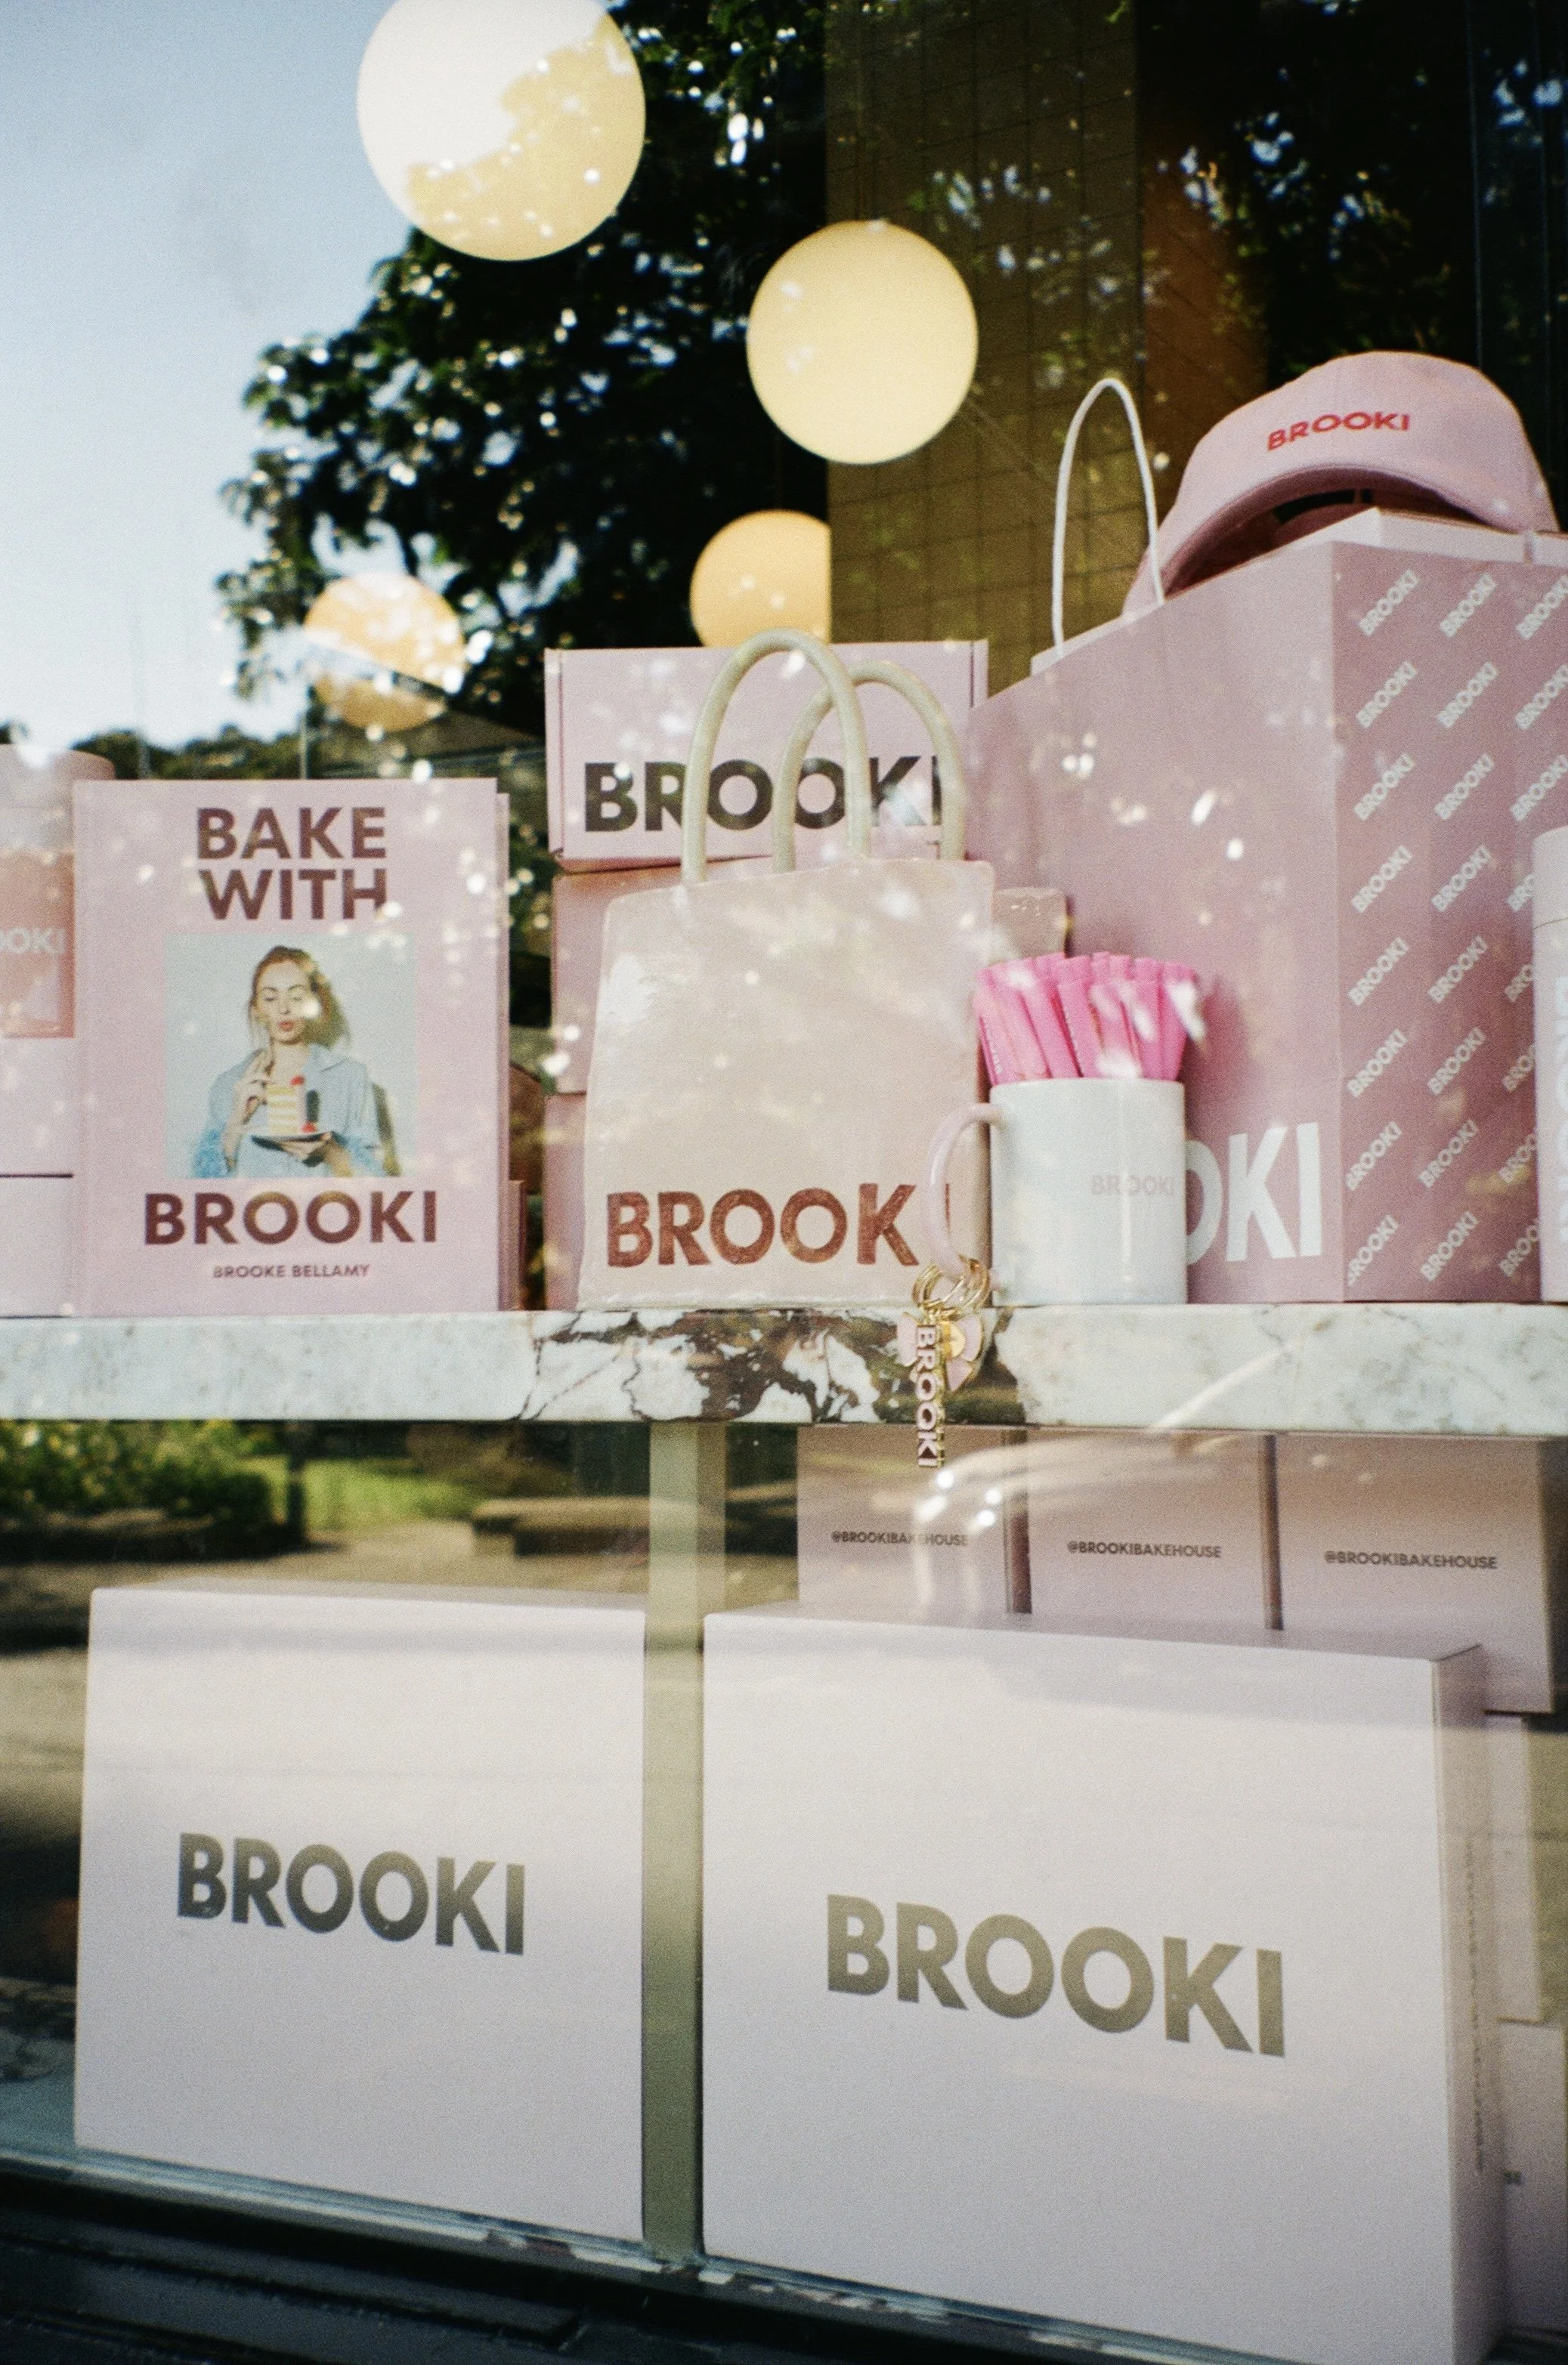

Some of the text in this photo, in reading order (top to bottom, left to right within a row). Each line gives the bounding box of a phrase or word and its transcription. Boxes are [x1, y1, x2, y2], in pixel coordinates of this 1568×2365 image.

[1267, 411, 1410, 451] BROOKI
[1359, 569, 1419, 636] BROOKI
[1440, 572, 1497, 638] BROOKI
[1356, 661, 1418, 730] BROOKI
[1437, 660, 1498, 729] BROOKI
[1353, 753, 1415, 821] BROOKI
[1435, 753, 1495, 821] BROOKI
[197, 807, 386, 859] BAKE
[197, 868, 387, 920] WITH
[1351, 845, 1412, 914] BROOKI
[1431, 845, 1491, 913] BROOKI
[0, 926, 66, 954] OKI
[1347, 936, 1410, 1006] BROOKI
[1427, 935, 1489, 1004] BROOKI
[1504, 963, 1533, 1003] BRO
[1347, 1028, 1409, 1099] BROOKI
[1427, 1027, 1487, 1096] BROOKI
[1346, 1121, 1403, 1192] BROOKI
[1418, 1119, 1479, 1188] BROOKI
[1498, 1133, 1537, 1185] BROO
[144, 1190, 438, 1245] BROOKI
[606, 1183, 951, 1268] BROOK
[1186, 1122, 1322, 1266] OKI
[213, 1264, 370, 1278] BROOKE BELLAMY
[1420, 1210, 1479, 1281] BROOKI
[1499, 1219, 1538, 1277] BROO
[909, 1325, 939, 1467] BROOKI
[1067, 1540, 1222, 1559] @BROOKIBAKEHOUSE
[1324, 1550, 1498, 1570] @BROOKIBAKEHOUSE
[177, 1832, 526, 1956] BROOKI
[827, 1894, 1285, 2058] BROOKI
